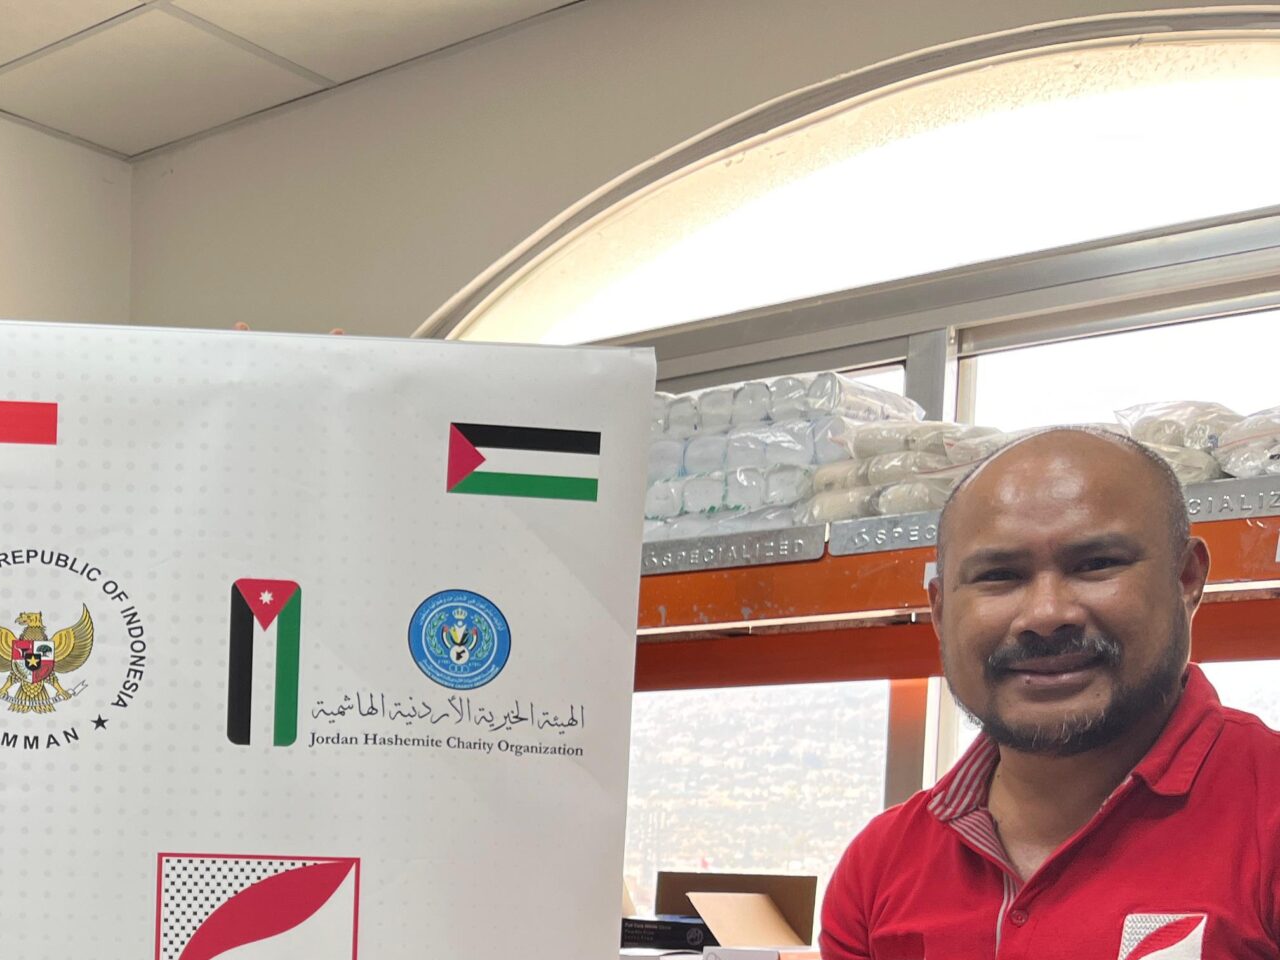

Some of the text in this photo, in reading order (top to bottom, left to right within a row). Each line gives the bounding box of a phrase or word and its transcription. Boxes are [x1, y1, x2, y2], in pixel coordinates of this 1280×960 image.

[662, 538, 805, 566] SPECIALIZED
[102, 580, 129, 604] OF
[110, 605, 147, 710] INDONESIA
[311, 691, 385, 724] الهاشمية
[474, 700, 534, 732] الخيرية
[537, 704, 584, 731] الهيئة
[308, 731, 584, 758] Jordan Hashemite Charity Organization
